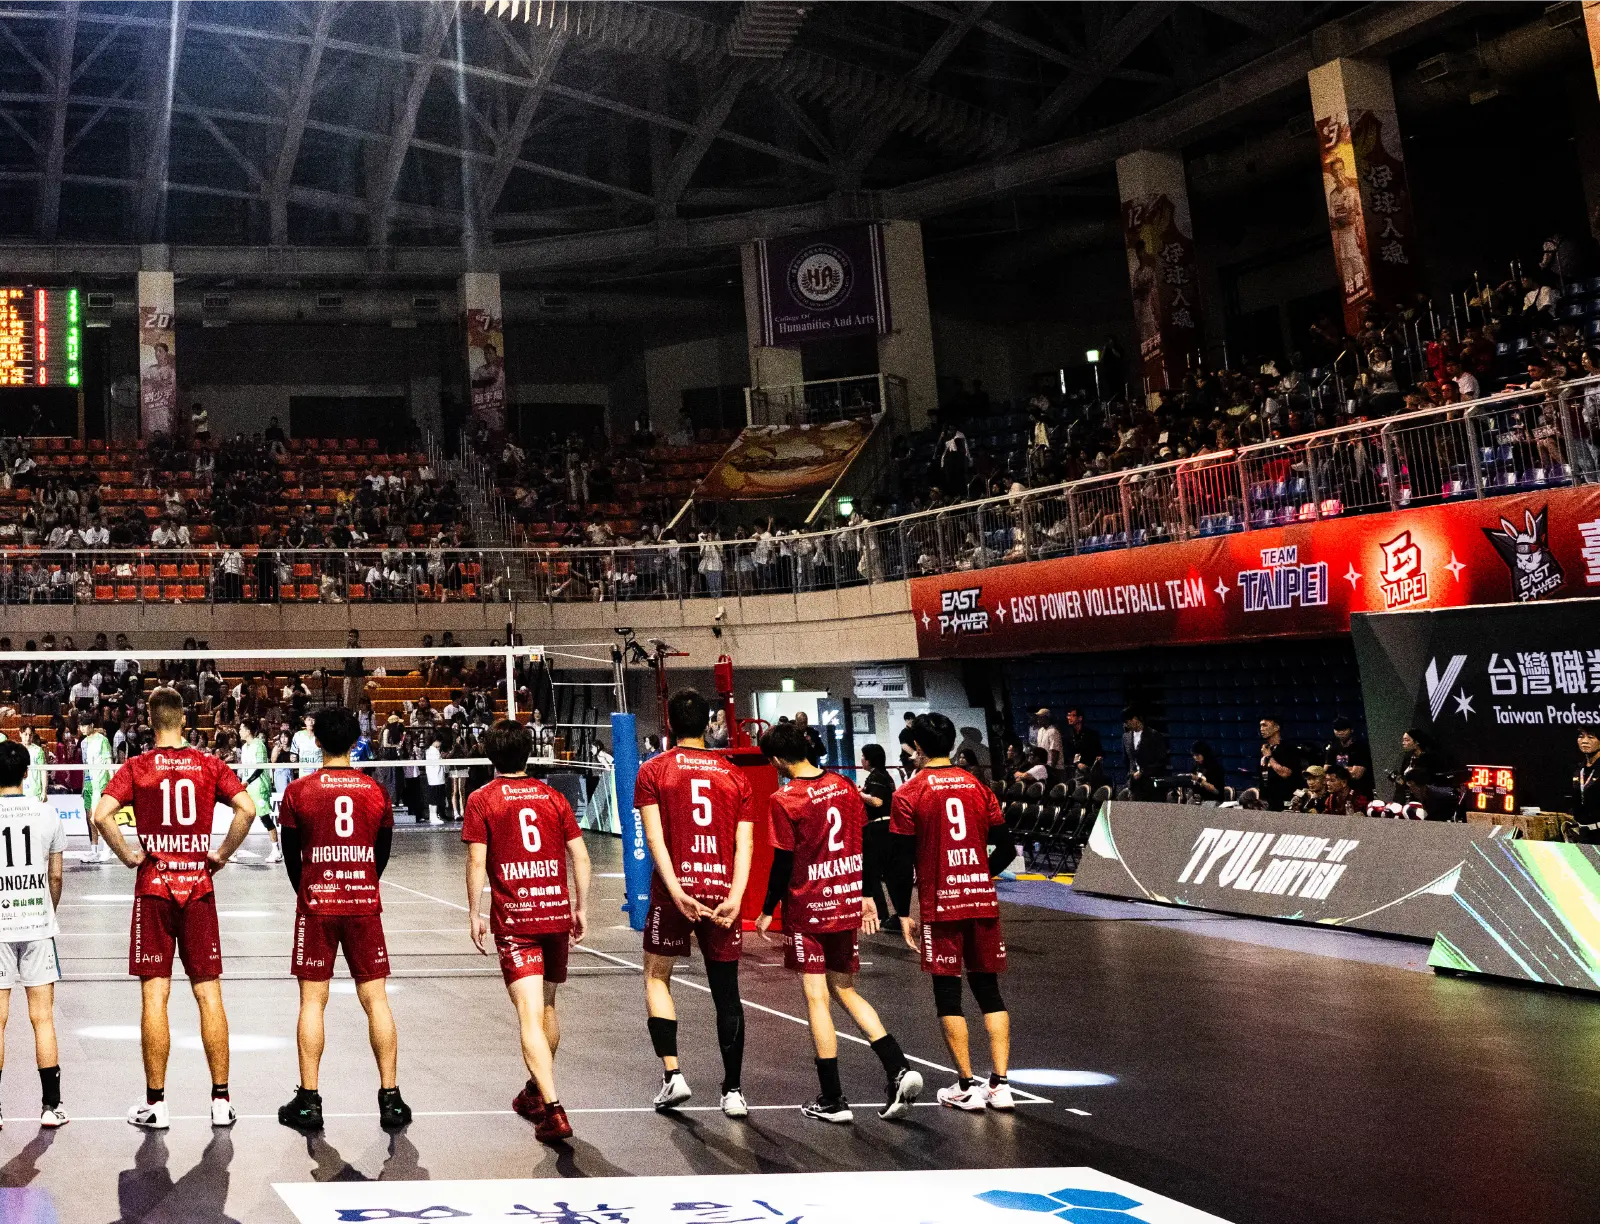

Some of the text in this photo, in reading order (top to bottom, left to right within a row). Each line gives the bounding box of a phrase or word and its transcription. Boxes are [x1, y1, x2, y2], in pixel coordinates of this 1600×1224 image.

[144, 314, 170, 328] 20
[779, 314, 875, 334] Humanities And Arts
[1261, 547, 1297, 566] TEAM
[1238, 562, 1328, 611] TAIPEI
[1519, 564, 1551, 590] EAST
[941, 589, 980, 611] EAST
[1010, 577, 1206, 624] EAST POWER VOLLEYBALL TEAM
[1384, 574, 1427, 608] TAIPEI
[1493, 703, 1600, 724] Taiwan Profess
[159, 778, 197, 826] 10
[691, 778, 712, 827] 5
[1478, 793, 1486, 809] 0
[1505, 795, 1514, 811] 0
[334, 795, 354, 838] 8
[945, 798, 967, 841] 9
[518, 807, 542, 853] 6
[827, 806, 844, 852] 2
[2, 825, 33, 867] 11
[140, 834, 211, 853] TAMMEAR
[312, 845, 375, 863] HIGURUMA
[691, 835, 717, 854] JIN
[1269, 834, 1360, 862] WARM-UP
[947, 848, 979, 867] KOTA
[500, 859, 559, 881] YAMAGIS
[1253, 858, 1347, 900] MATCH
[12, 897, 43, 907] 森山病院
[663, 938, 684, 946] Arai
[142, 953, 163, 963] Arai
[305, 957, 325, 967] Arai
[808, 953, 824, 963] Ara
[936, 954, 957, 964] Arai
